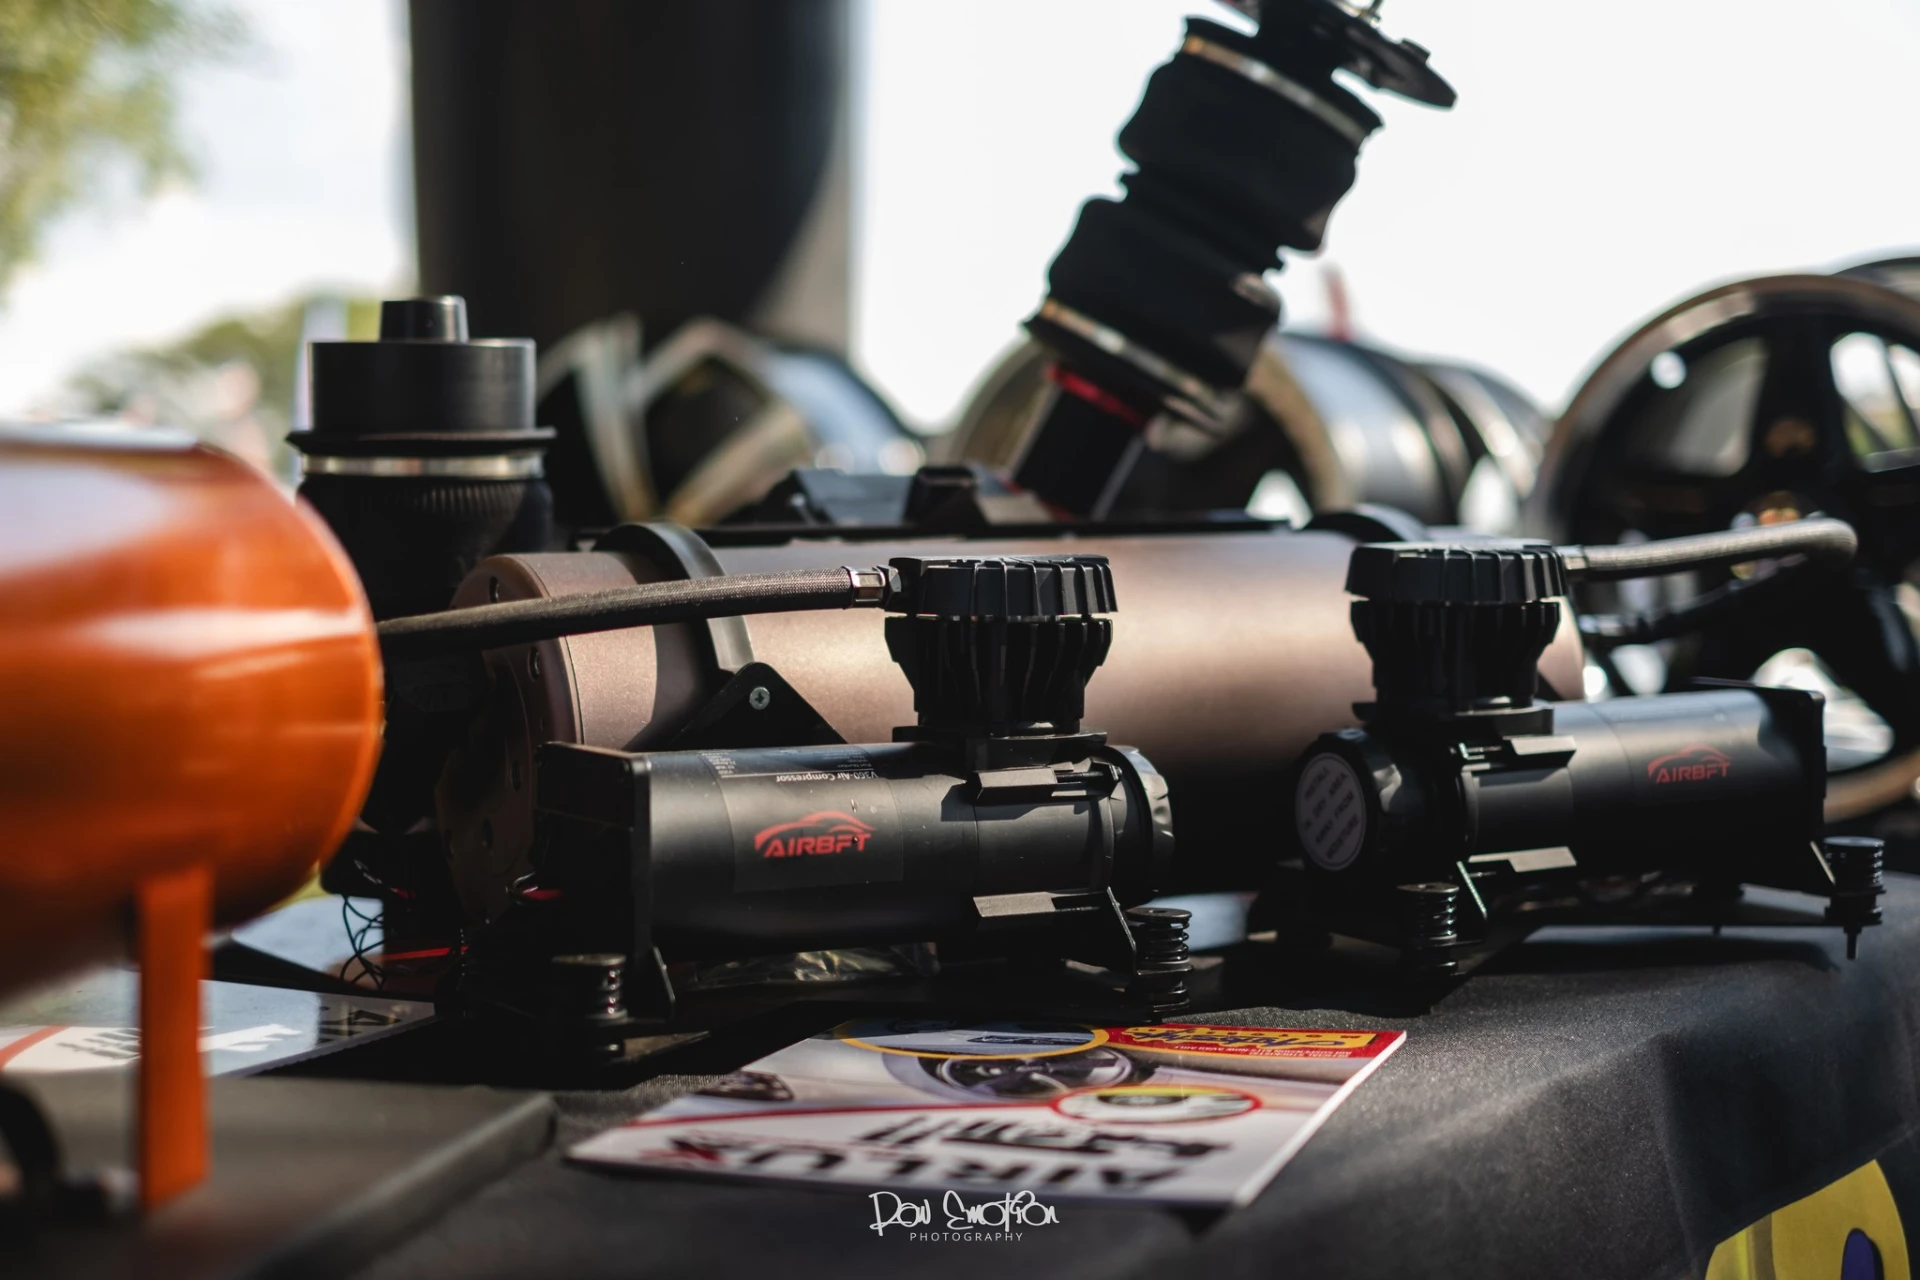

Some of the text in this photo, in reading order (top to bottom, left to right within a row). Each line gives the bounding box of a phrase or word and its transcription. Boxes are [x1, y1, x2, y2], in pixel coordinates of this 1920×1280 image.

[776, 771, 836, 783] Compressor
[1655, 761, 1732, 784] AIRBFT
[763, 832, 872, 858] AIRBFT
